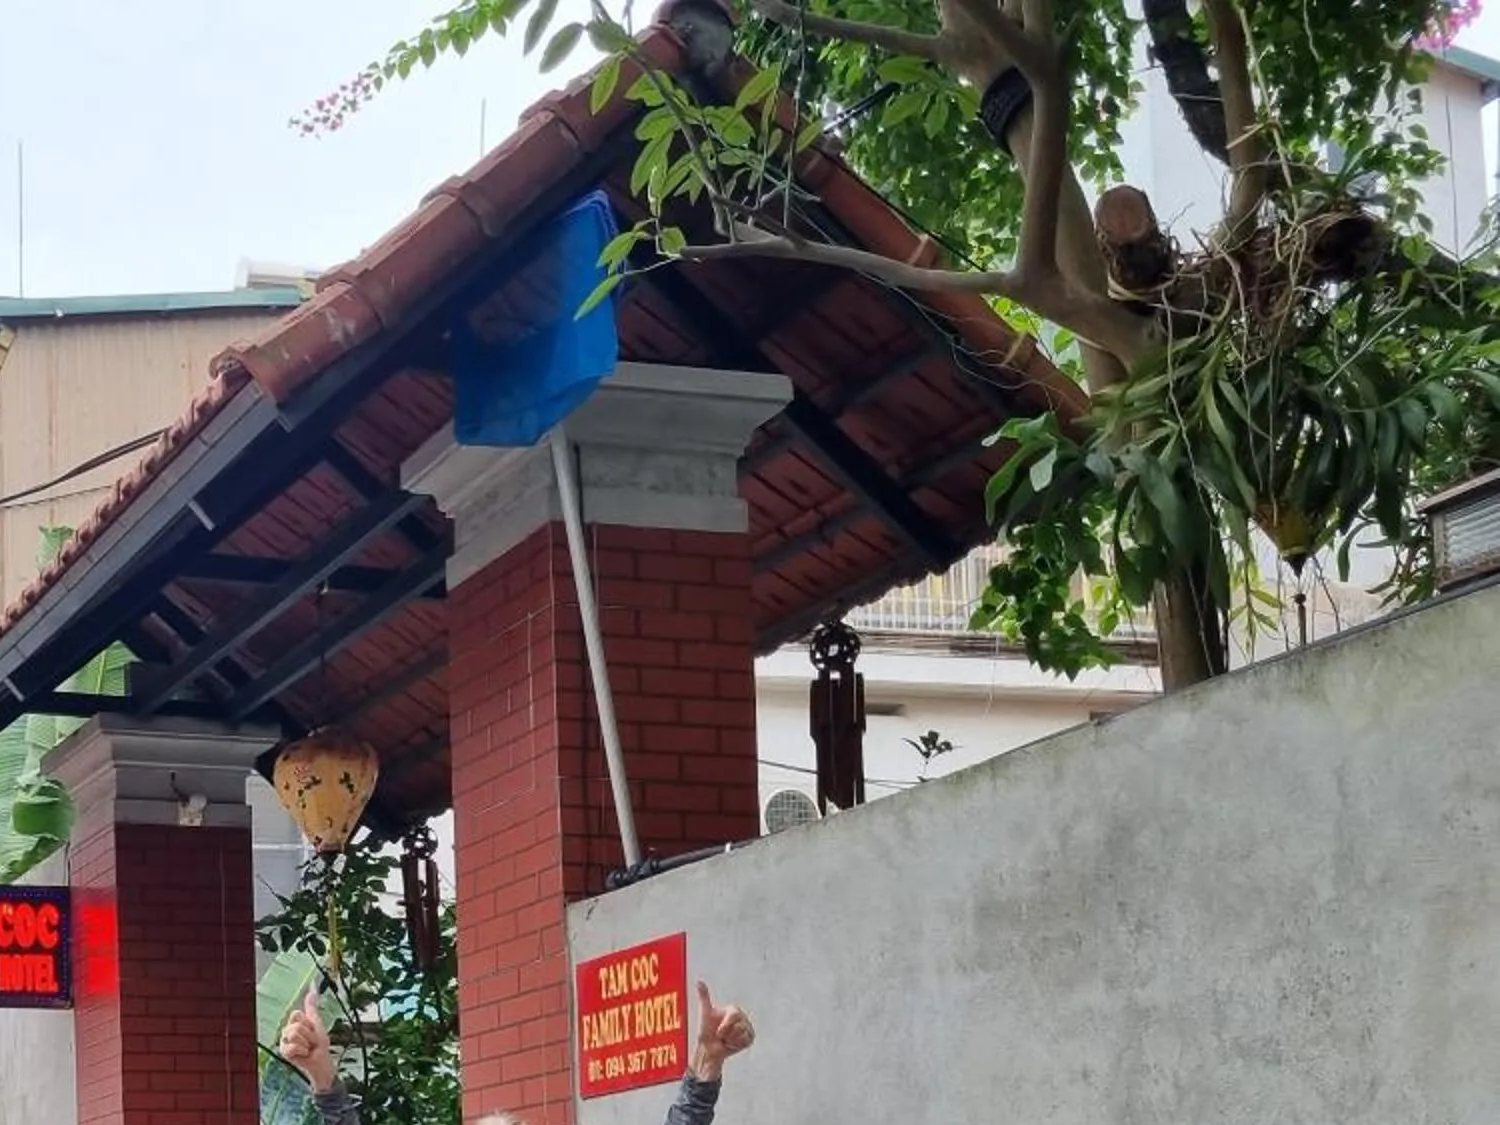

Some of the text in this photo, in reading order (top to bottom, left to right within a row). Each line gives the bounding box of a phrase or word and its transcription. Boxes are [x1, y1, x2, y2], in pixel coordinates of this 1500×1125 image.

[599, 953, 659, 1000] TAM COC
[582, 992, 681, 1051] FAMILY HOTEL
[605, 1054, 625, 1079] 094
[627, 1050, 647, 1075] 367
